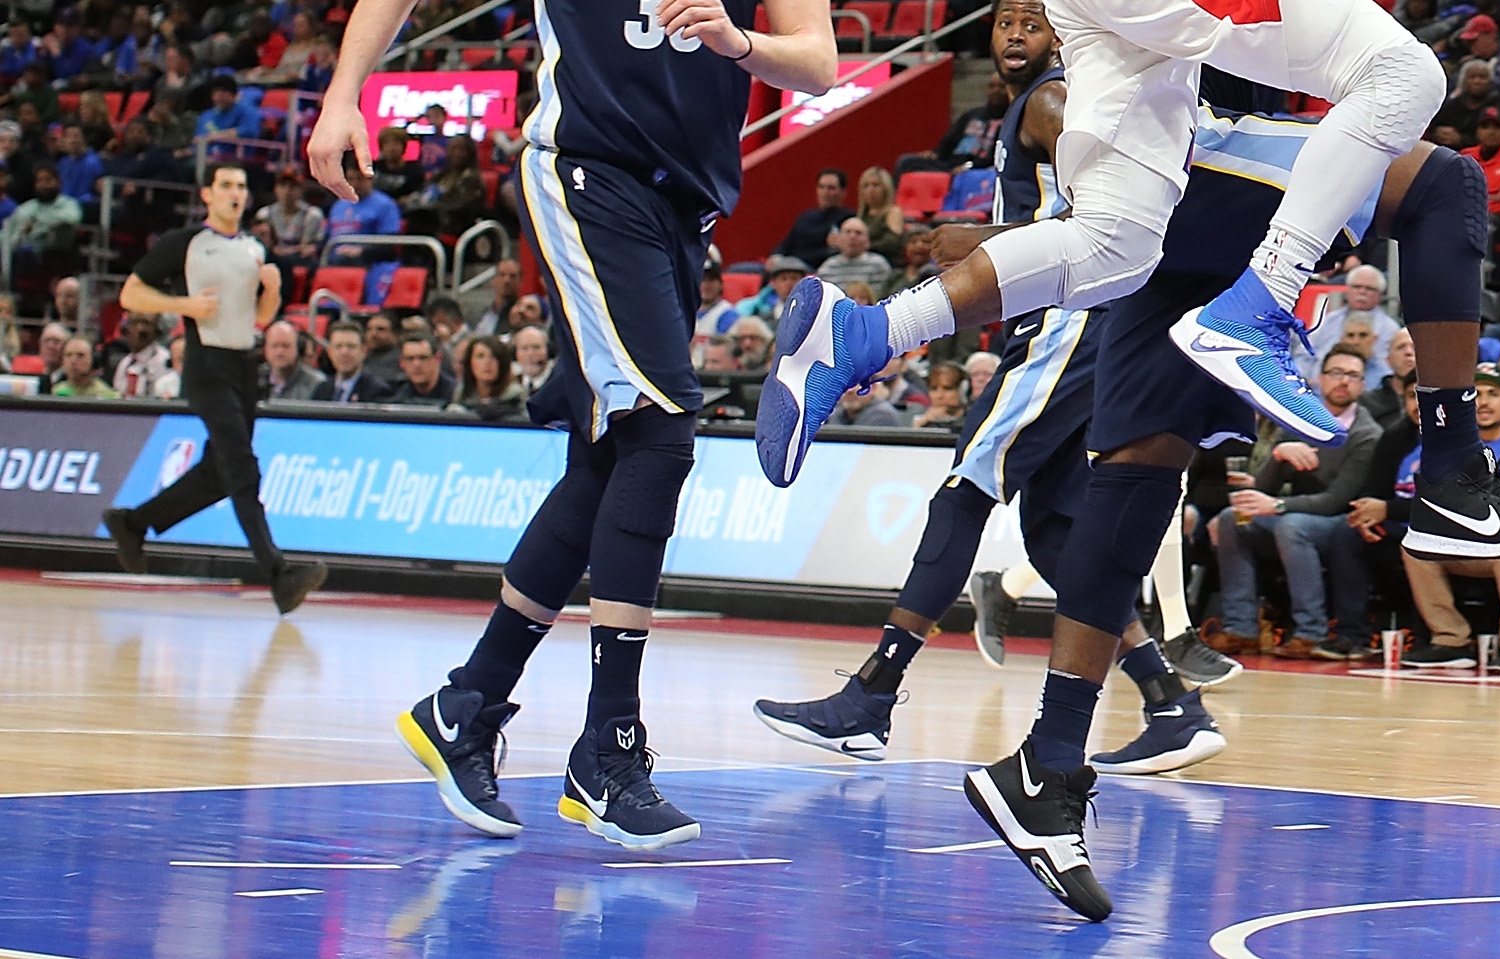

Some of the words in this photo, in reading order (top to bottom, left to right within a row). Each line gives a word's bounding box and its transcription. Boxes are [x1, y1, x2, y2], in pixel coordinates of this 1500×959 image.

[0, 448, 101, 495] DUEL
[266, 452, 363, 520] Official
[356, 456, 438, 534] 1-Day
[681, 477, 722, 539] he
[724, 476, 790, 542] NBA
